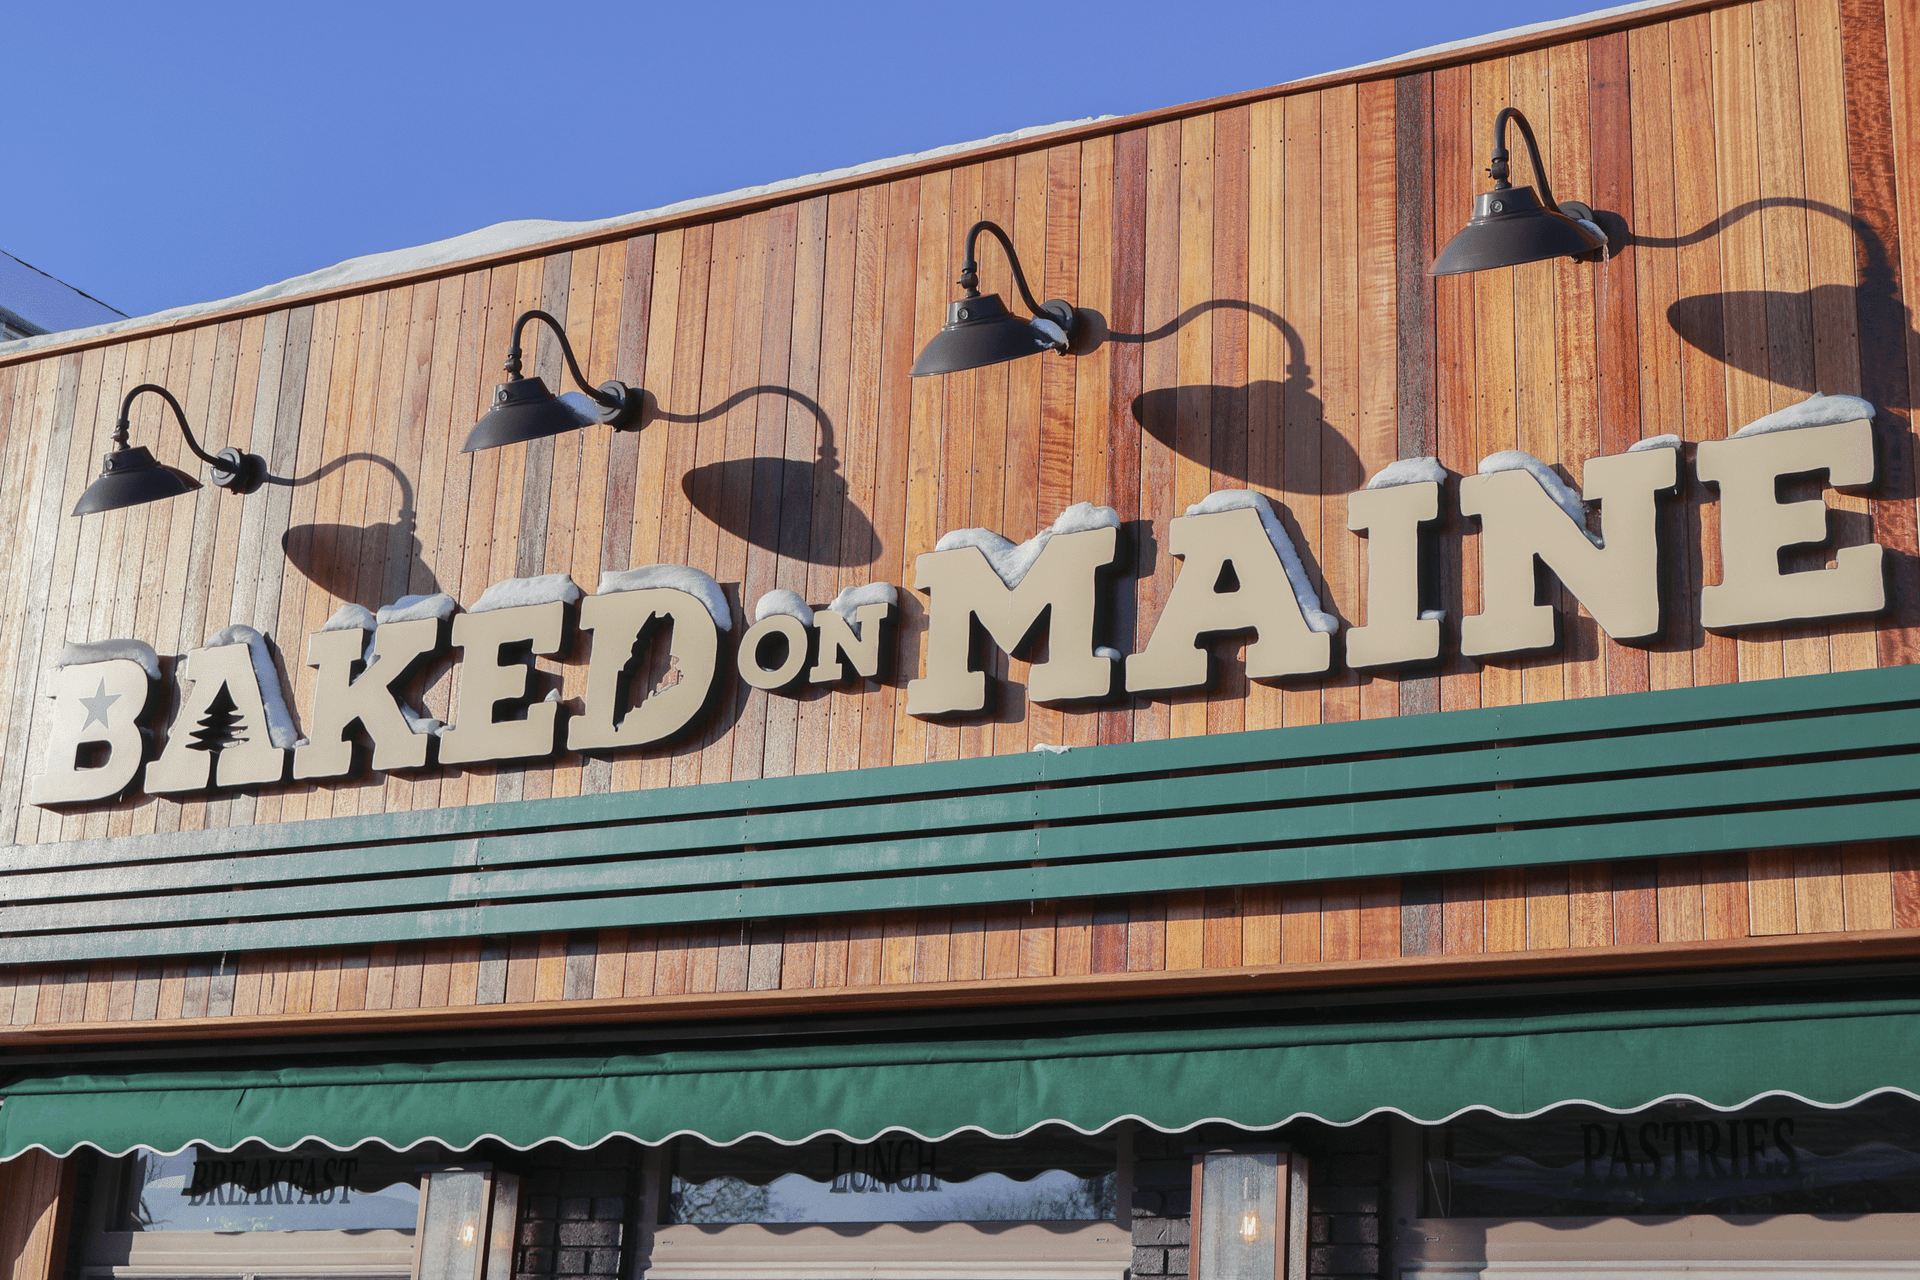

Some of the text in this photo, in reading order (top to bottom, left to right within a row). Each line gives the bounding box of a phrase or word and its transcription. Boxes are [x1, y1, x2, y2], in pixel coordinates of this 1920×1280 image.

[30, 417, 1888, 808] BAKED ON MAINE
[829, 1140, 942, 1194] LUNCH
[1580, 1116, 1802, 1183] PASTRIES
[188, 1157, 360, 1207] BREAKFAST
